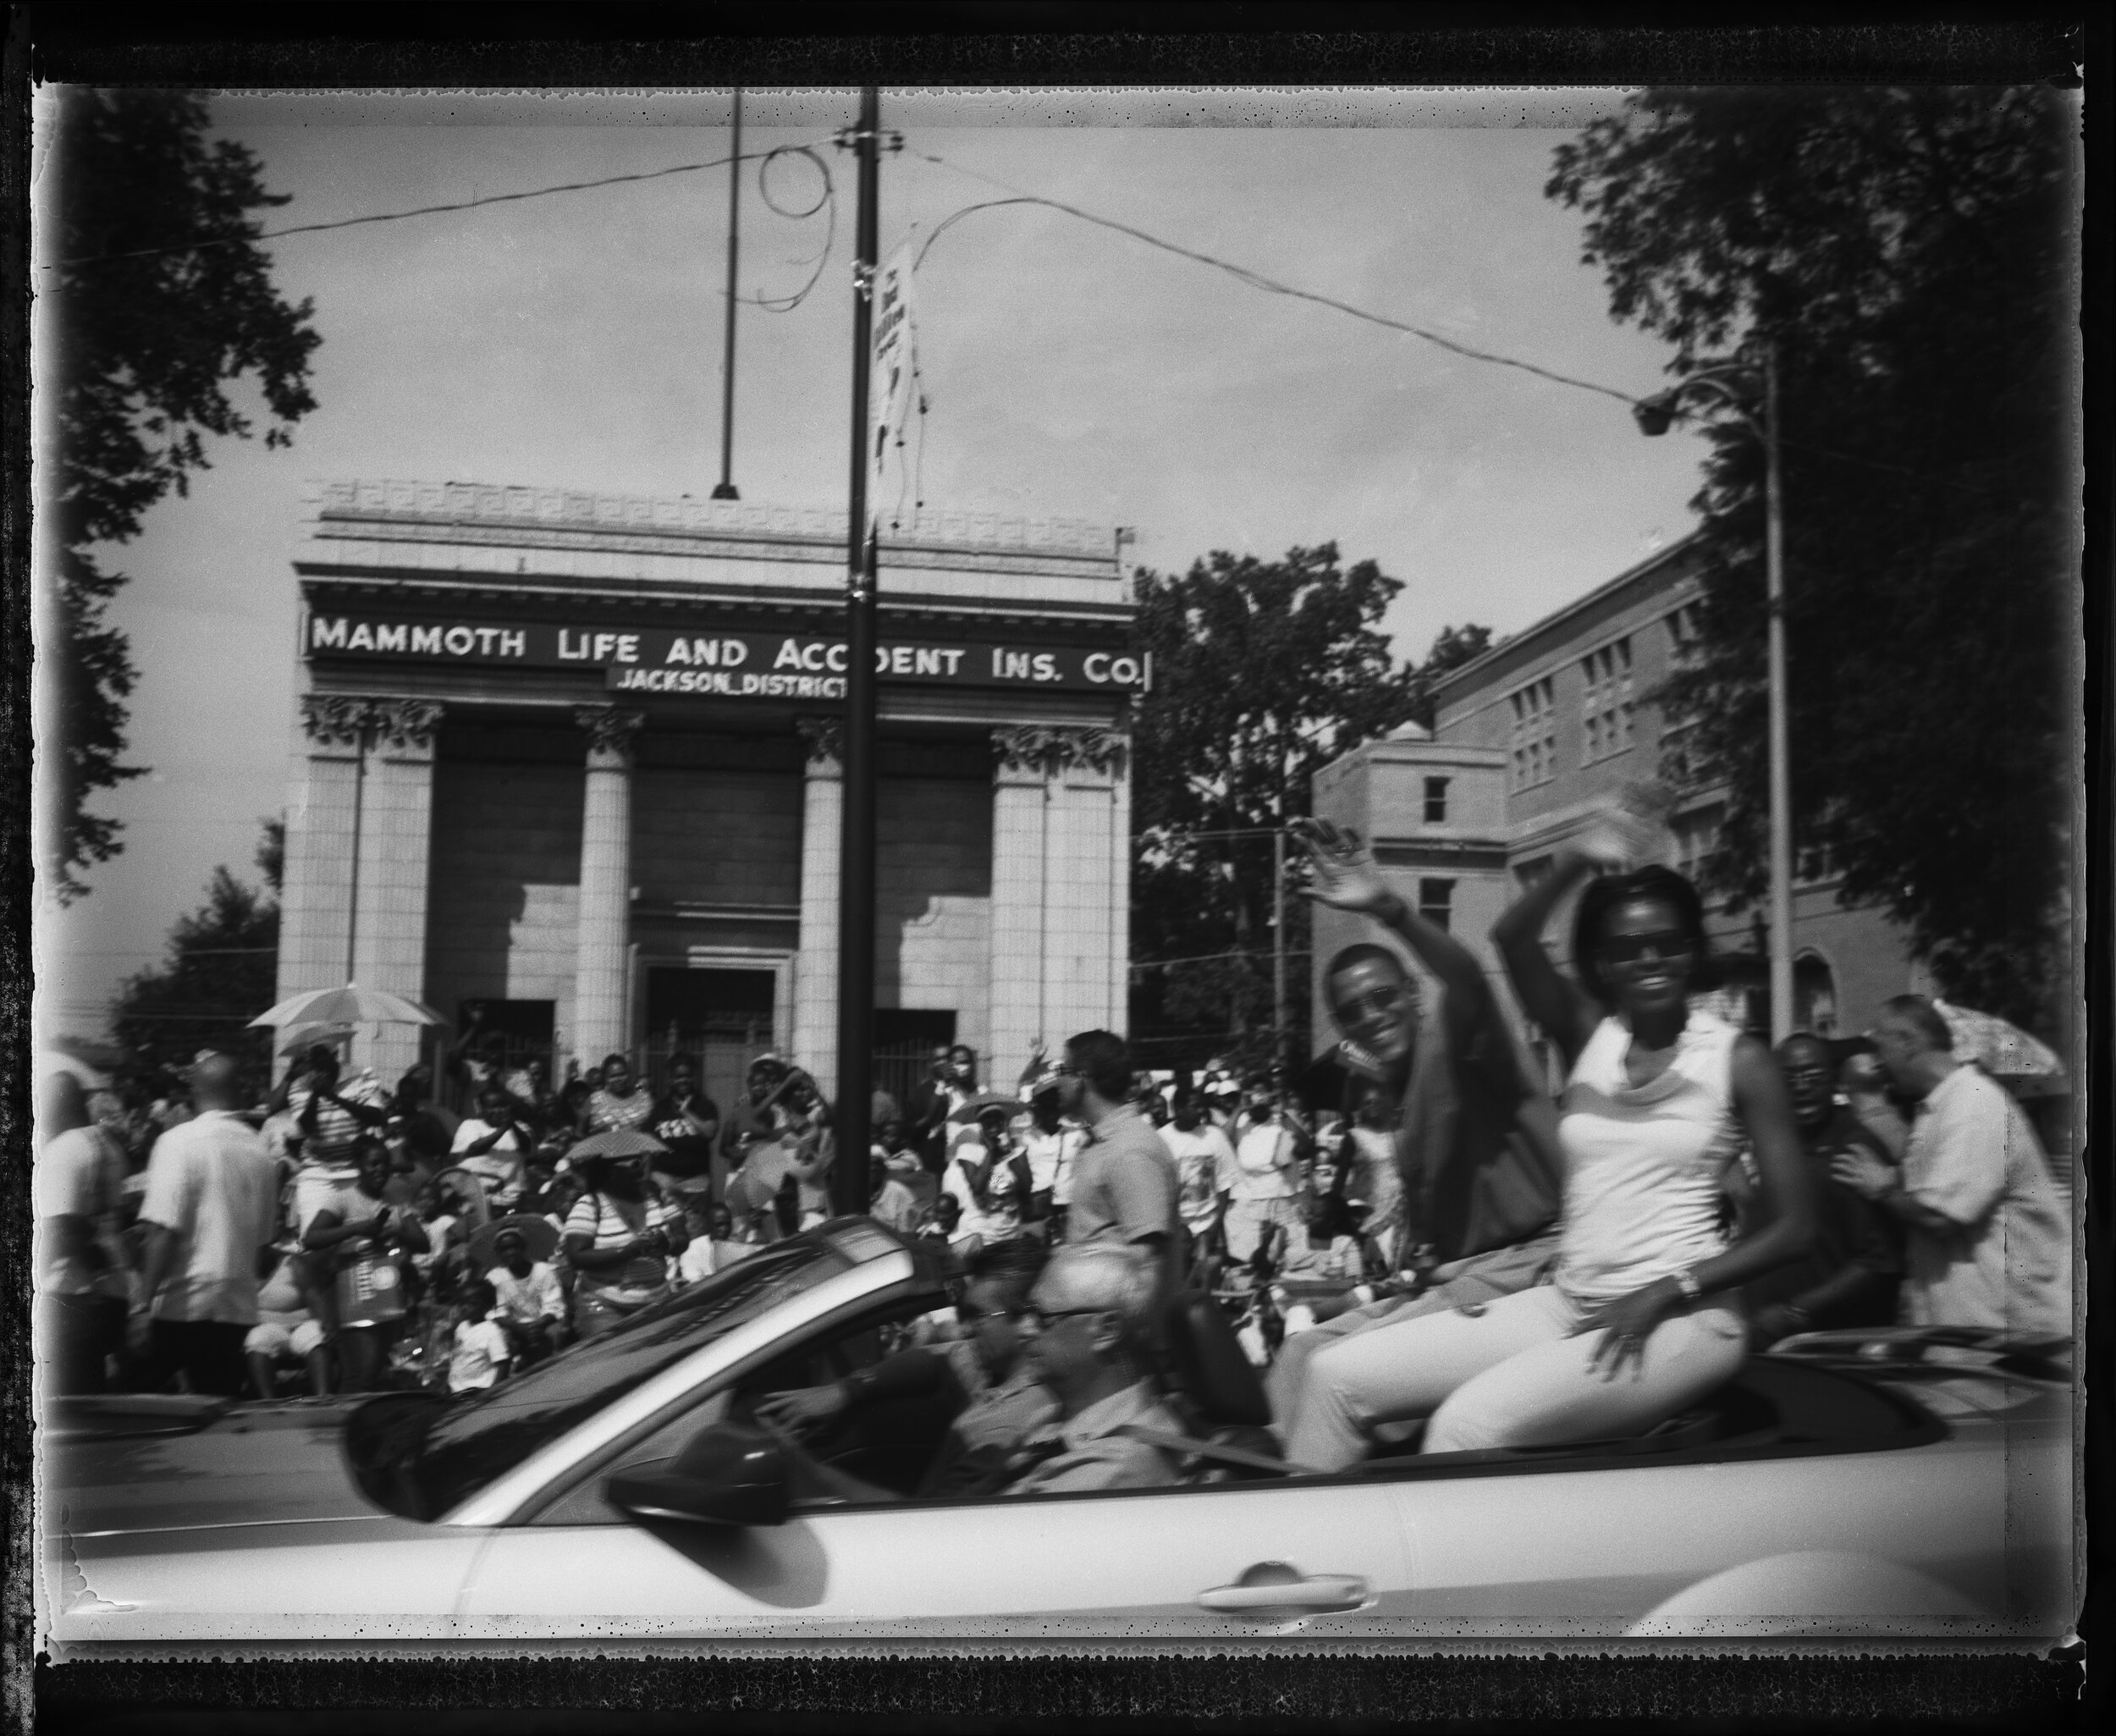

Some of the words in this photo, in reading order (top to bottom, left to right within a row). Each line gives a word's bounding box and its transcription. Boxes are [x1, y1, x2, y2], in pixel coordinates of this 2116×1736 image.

[312, 617, 526, 657] MAMMOTH
[558, 628, 641, 663] LIFE
[664, 637, 748, 667] AND
[772, 638, 966, 676] ACCDENT
[992, 648, 1063, 681] INS.
[1083, 653, 1143, 685] CO.
[616, 669, 730, 691] JACKSON
